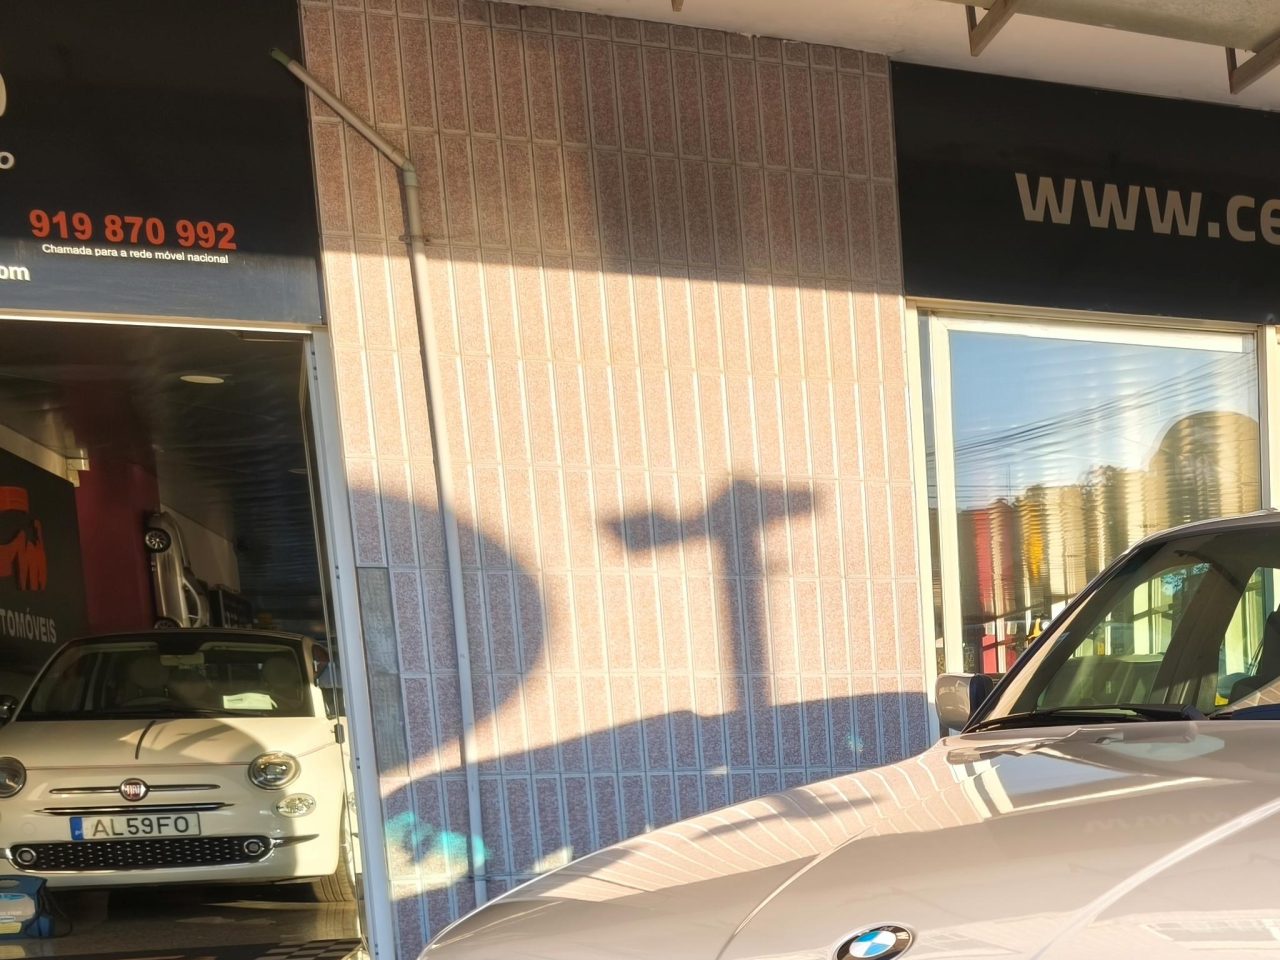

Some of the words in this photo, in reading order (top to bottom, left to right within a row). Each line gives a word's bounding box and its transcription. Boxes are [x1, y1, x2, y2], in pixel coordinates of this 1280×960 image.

[28, 209, 93, 241] 919
[104, 214, 165, 246] 870
[175, 219, 237, 250] 992
[41, 243, 93, 256] Chamada
[94, 247, 118, 258] para
[120, 250, 128, 258] a
[129, 248, 153, 260] rede
[154, 249, 186, 262] móvel
[187, 252, 229, 264] nacional
